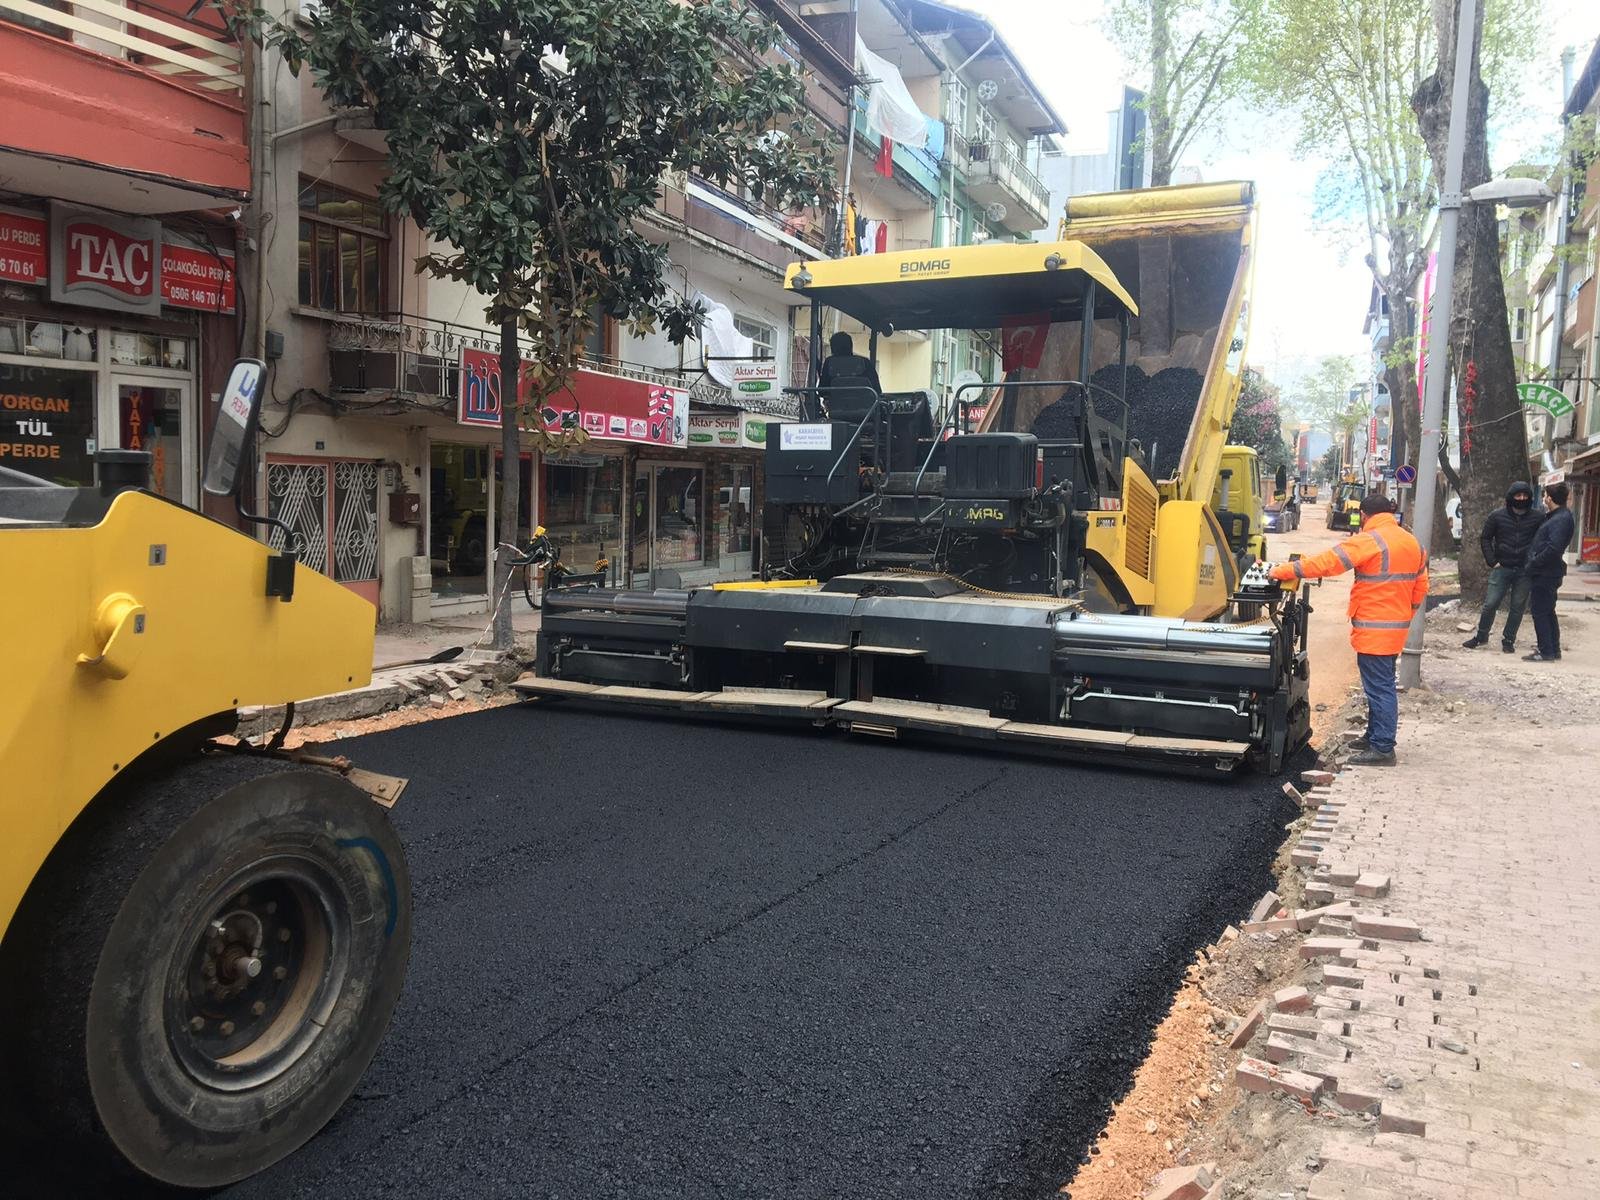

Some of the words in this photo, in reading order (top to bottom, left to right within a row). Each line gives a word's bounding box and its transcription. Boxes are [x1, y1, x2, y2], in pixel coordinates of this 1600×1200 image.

[11, 229, 41, 247] PERDE
[8, 259, 20, 274] 70
[22, 262, 34, 277] 61
[162, 258, 207, 278] ÇOLAKOĞLU
[900, 259, 951, 273] BOMAG
[170, 286, 190, 301] 0506
[191, 289, 206, 304] 146
[206, 292, 217, 305] 70
[734, 366, 754, 376] Aktar
[756, 365, 776, 377] Serpil
[16, 418, 53, 437] TÜL
[689, 417, 713, 428] Aktar
[715, 418, 740, 431] Serpil
[0, 443, 60, 459] PERDE
